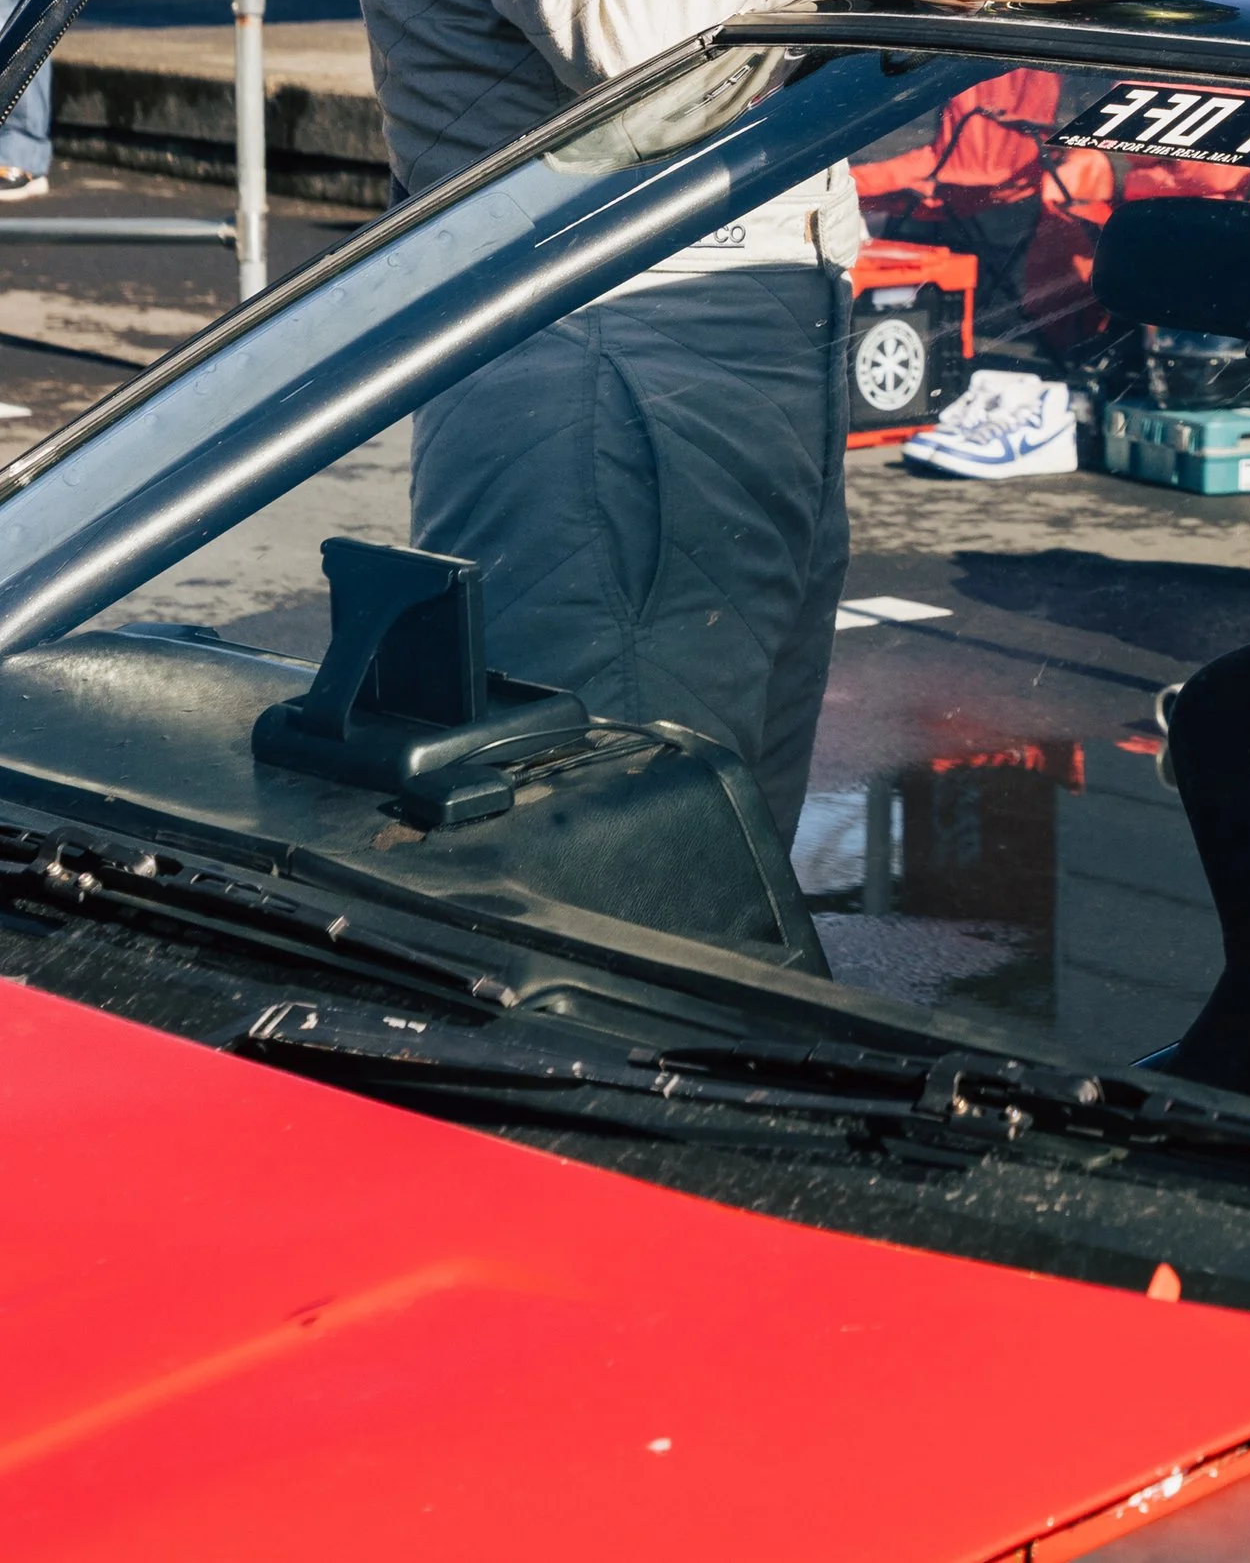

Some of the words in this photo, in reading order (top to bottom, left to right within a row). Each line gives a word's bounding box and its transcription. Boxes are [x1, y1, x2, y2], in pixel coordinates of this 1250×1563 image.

[1113, 141, 1144, 154] FOR
[1143, 144, 1173, 156] THE
[1171, 147, 1207, 160] REAL
[1207, 152, 1244, 164] MAN
